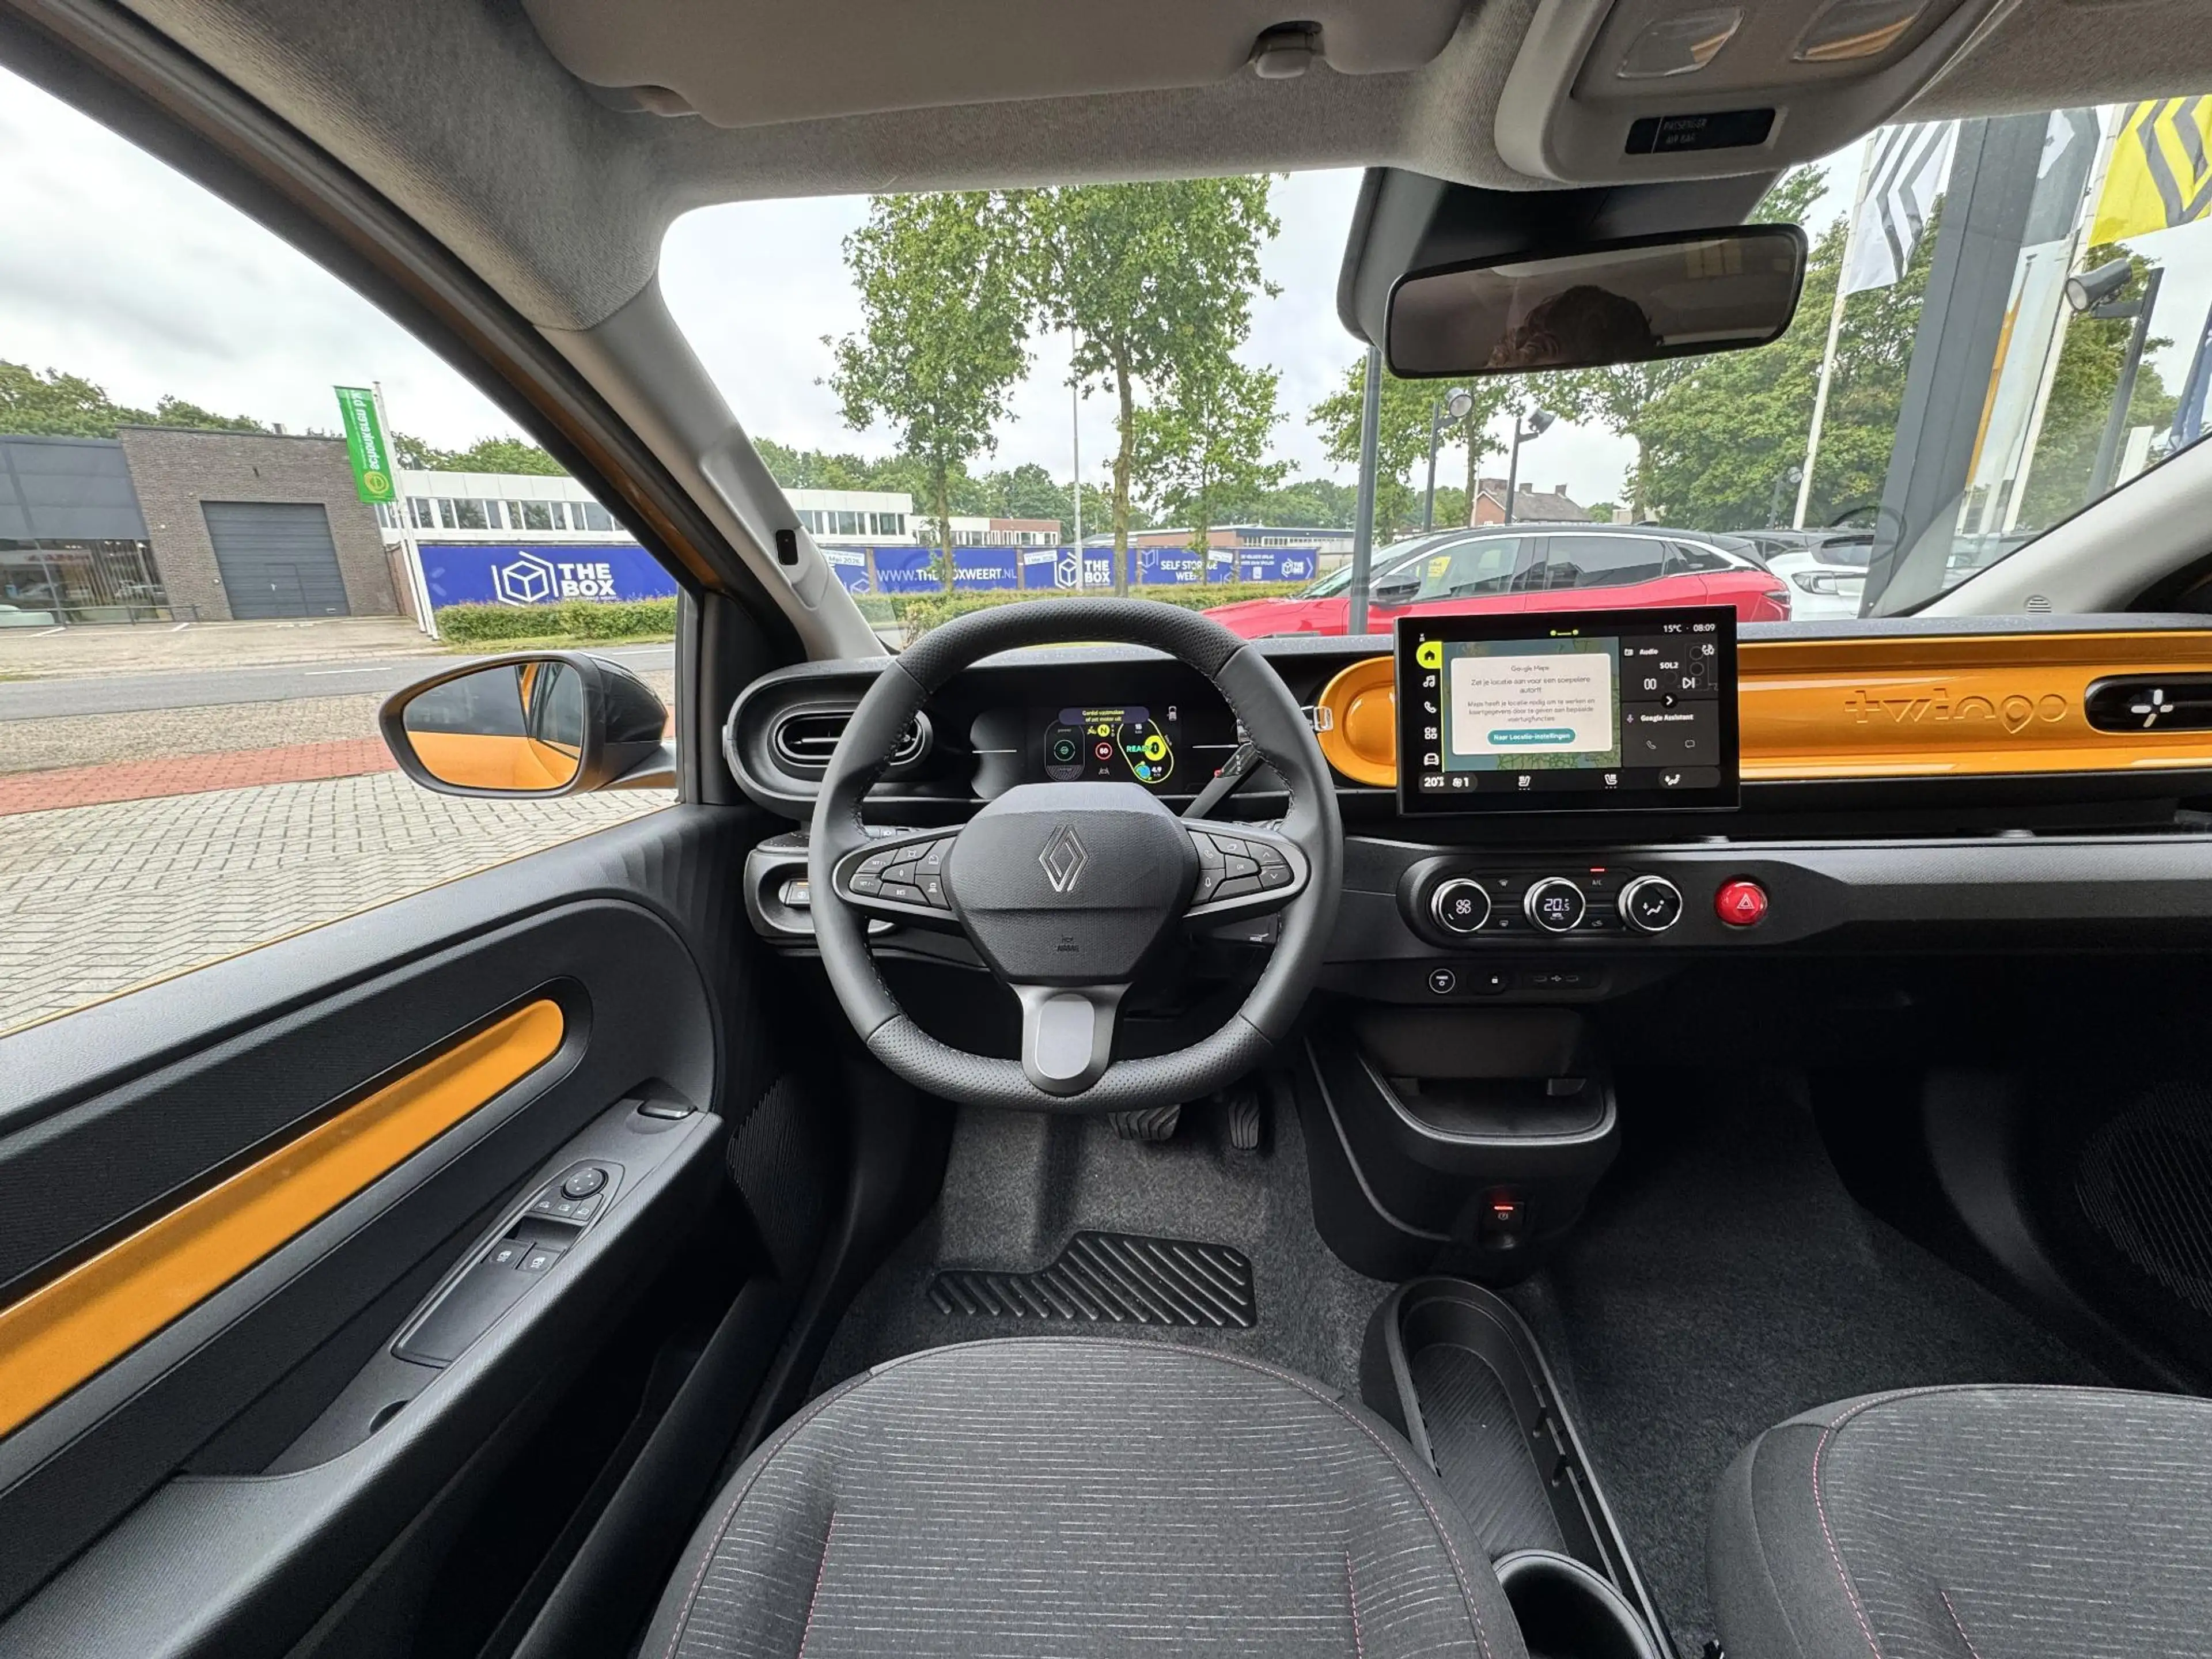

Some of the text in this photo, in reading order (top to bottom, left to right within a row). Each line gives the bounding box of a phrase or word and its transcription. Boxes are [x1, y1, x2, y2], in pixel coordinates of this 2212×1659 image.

[1084, 560, 1109, 571] THE
[1160, 559, 1218, 570] SELF STORGE
[557, 563, 612, 580] THE
[877, 568, 1017, 582] WWW.THEOXWEERT.NL
[1084, 571, 1111, 583] BOX
[560, 579, 617, 597] BOX
[1693, 624, 1715, 632] 08:09
[1483, 679, 1490, 687] je
[1557, 676, 1590, 684] soepelere
[1468, 707, 1512, 716] kaartgegevens
[1566, 706, 1593, 714] bepaalde
[1508, 715, 1555, 724] voertuigfuncties
[1641, 714, 1663, 722] Google
